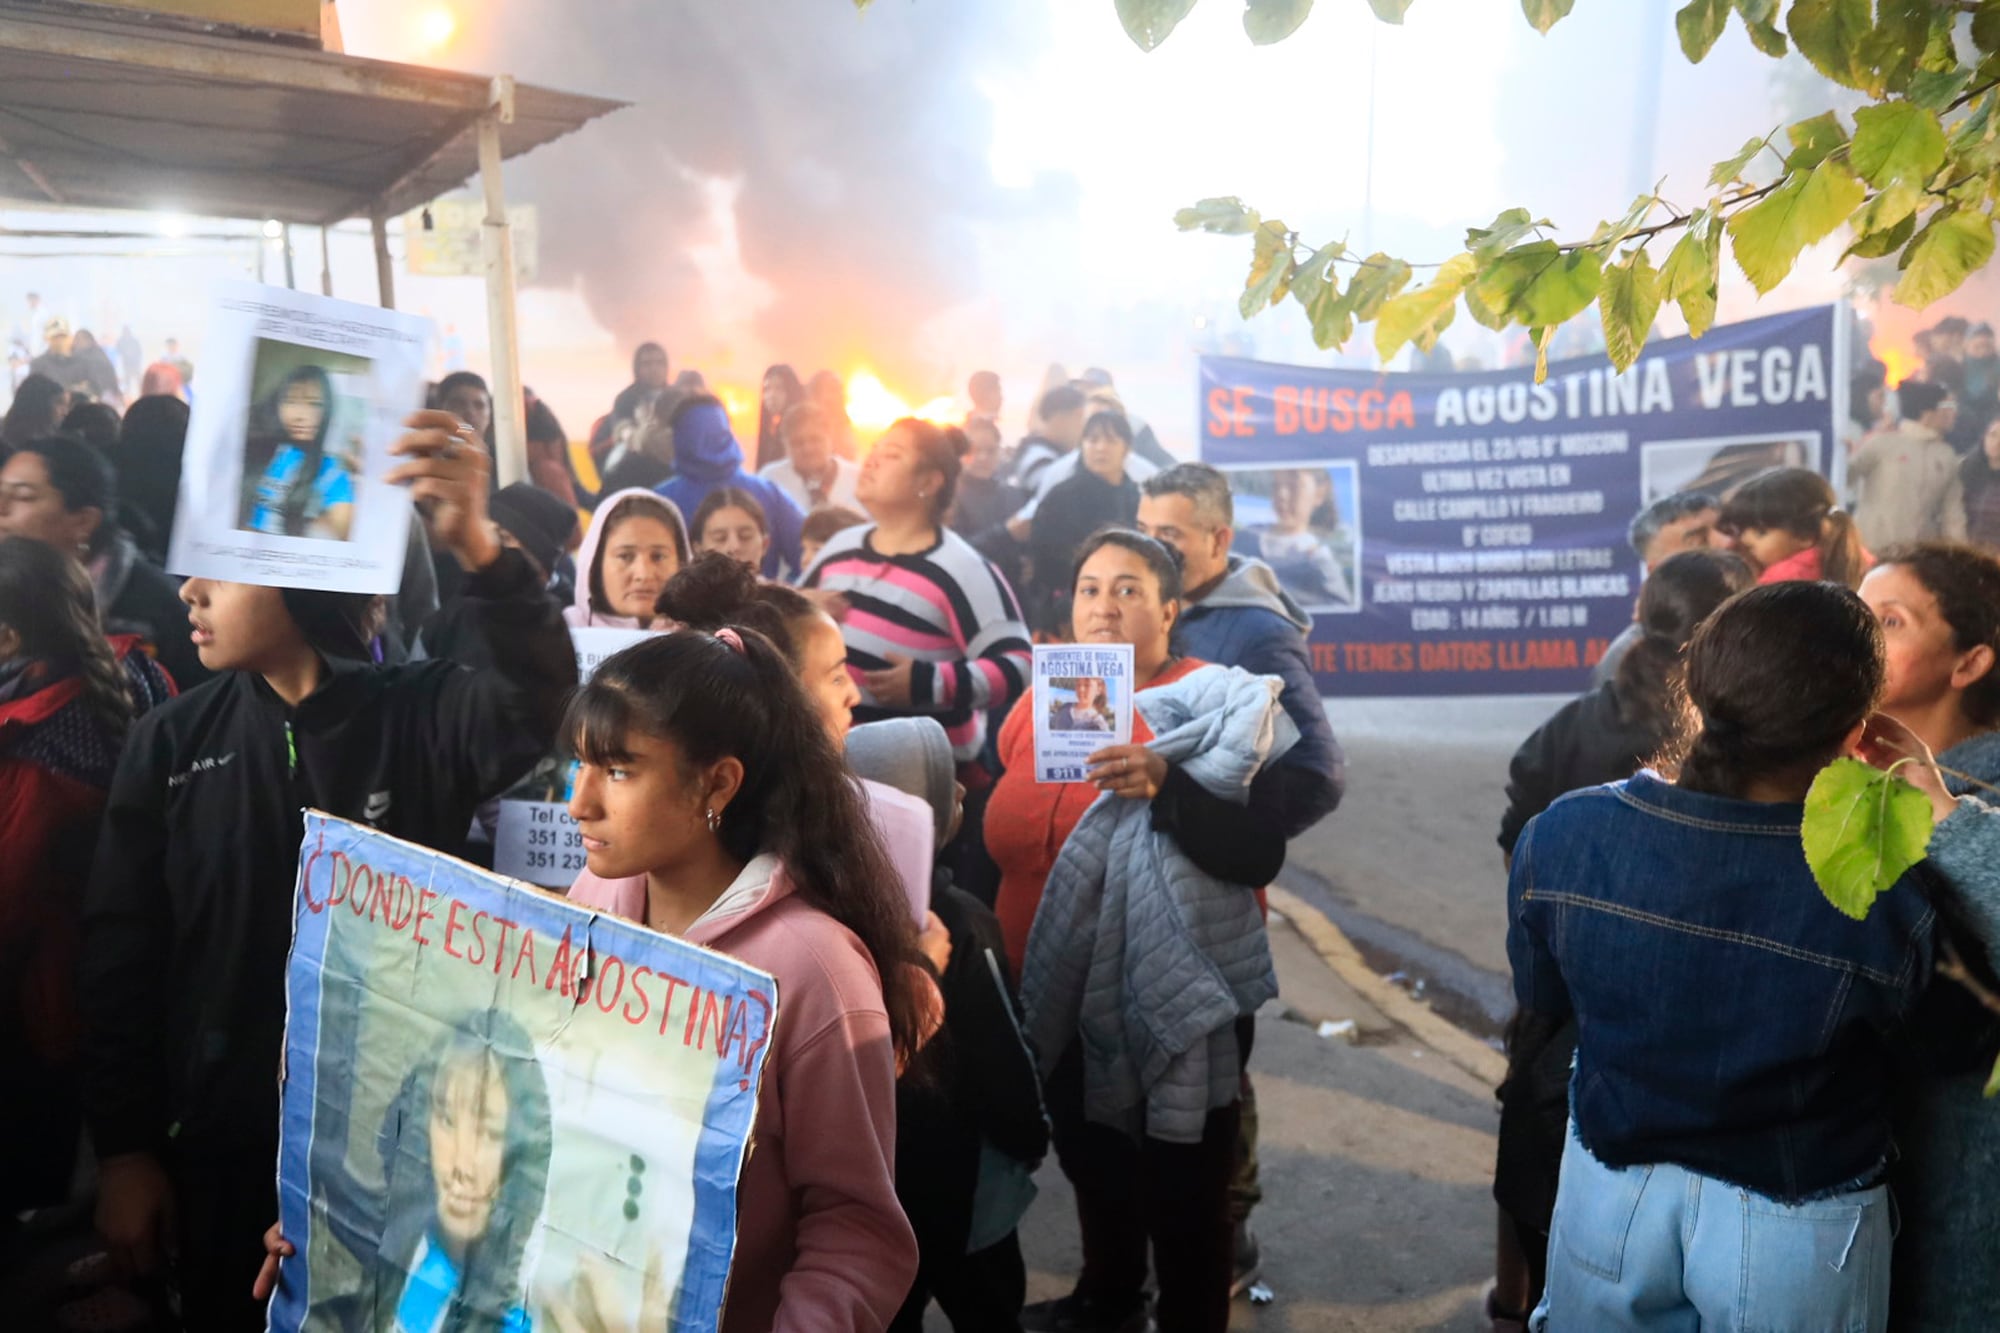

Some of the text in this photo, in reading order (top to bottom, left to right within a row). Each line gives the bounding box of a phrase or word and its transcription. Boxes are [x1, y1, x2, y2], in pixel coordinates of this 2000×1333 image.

[1207, 344, 1827, 437] SE BUSCA AGOSTINA VEGA
[1393, 499, 1437, 523] CALLE
[1511, 496, 1522, 516] Y
[1557, 548, 1613, 570] LETRAS
[1465, 579, 1476, 600] Y
[1561, 573, 1630, 598] BLANCAS
[1344, 642, 1413, 672] TENES
[1419, 640, 1493, 671] DATOS
[1498, 639, 1579, 670] LLAMA
[1041, 661, 1124, 676] AGOSTINA VEGA
[192, 757, 215, 773] AIR
[1053, 768, 1076, 780] 911
[530, 807, 579, 826] Tel co
[528, 829, 583, 848] 351 39
[526, 851, 555, 868] 351
[443, 899, 537, 985] ESTA
[545, 924, 772, 1092] AGOSTINA?
